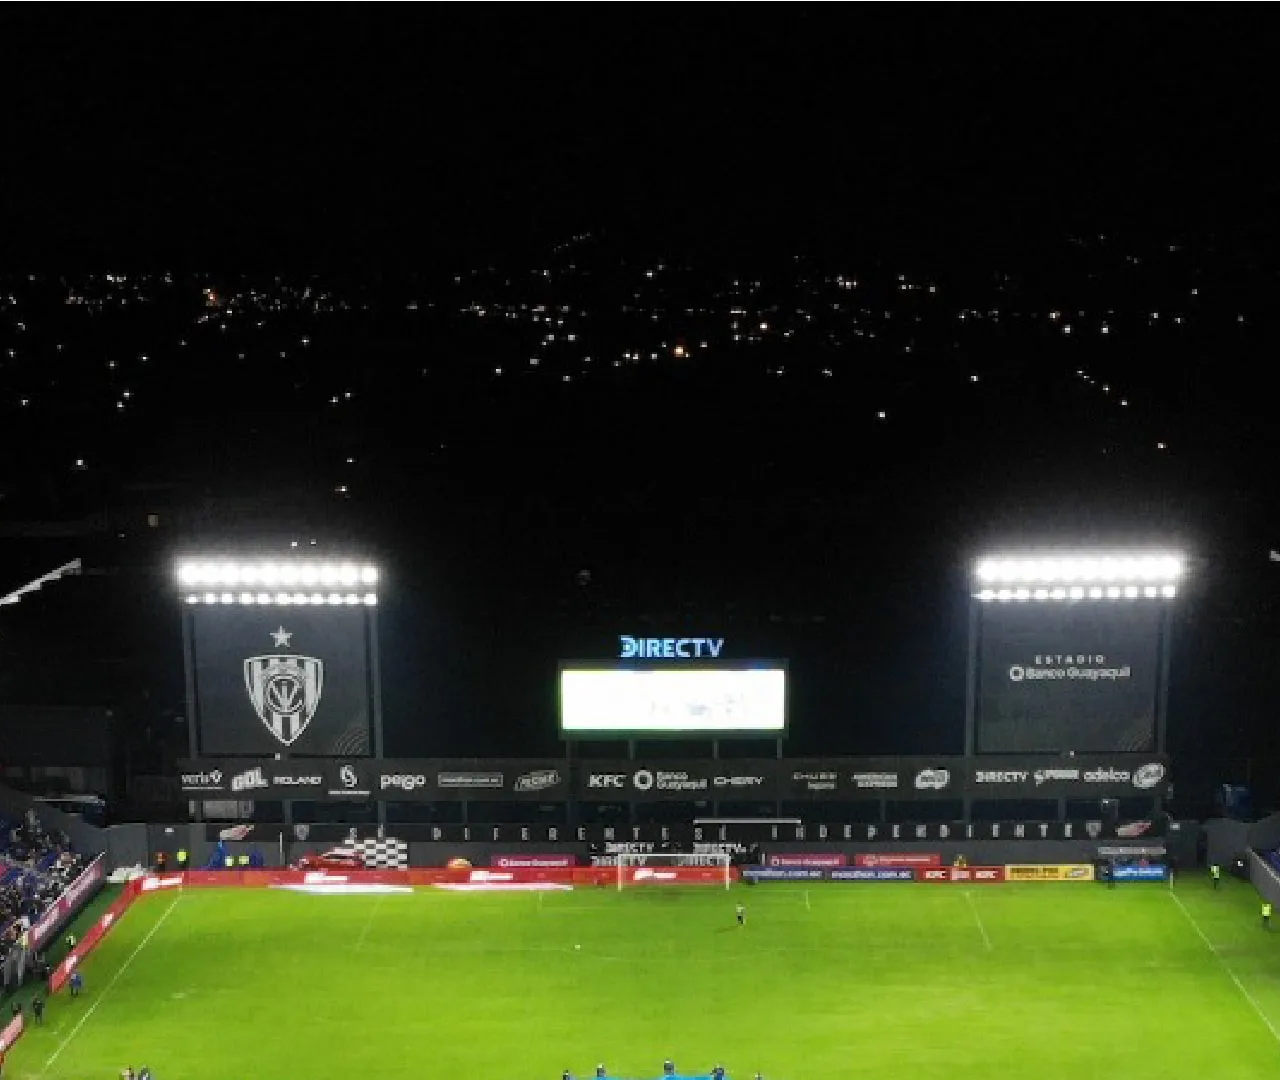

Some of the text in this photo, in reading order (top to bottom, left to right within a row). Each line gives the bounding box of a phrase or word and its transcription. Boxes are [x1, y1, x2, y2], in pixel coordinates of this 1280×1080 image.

[619, 635, 725, 658] DIRECTV
[1035, 654, 1106, 665] ESTADIO
[1025, 667, 1065, 680] Banco
[588, 773, 627, 788] KFC
